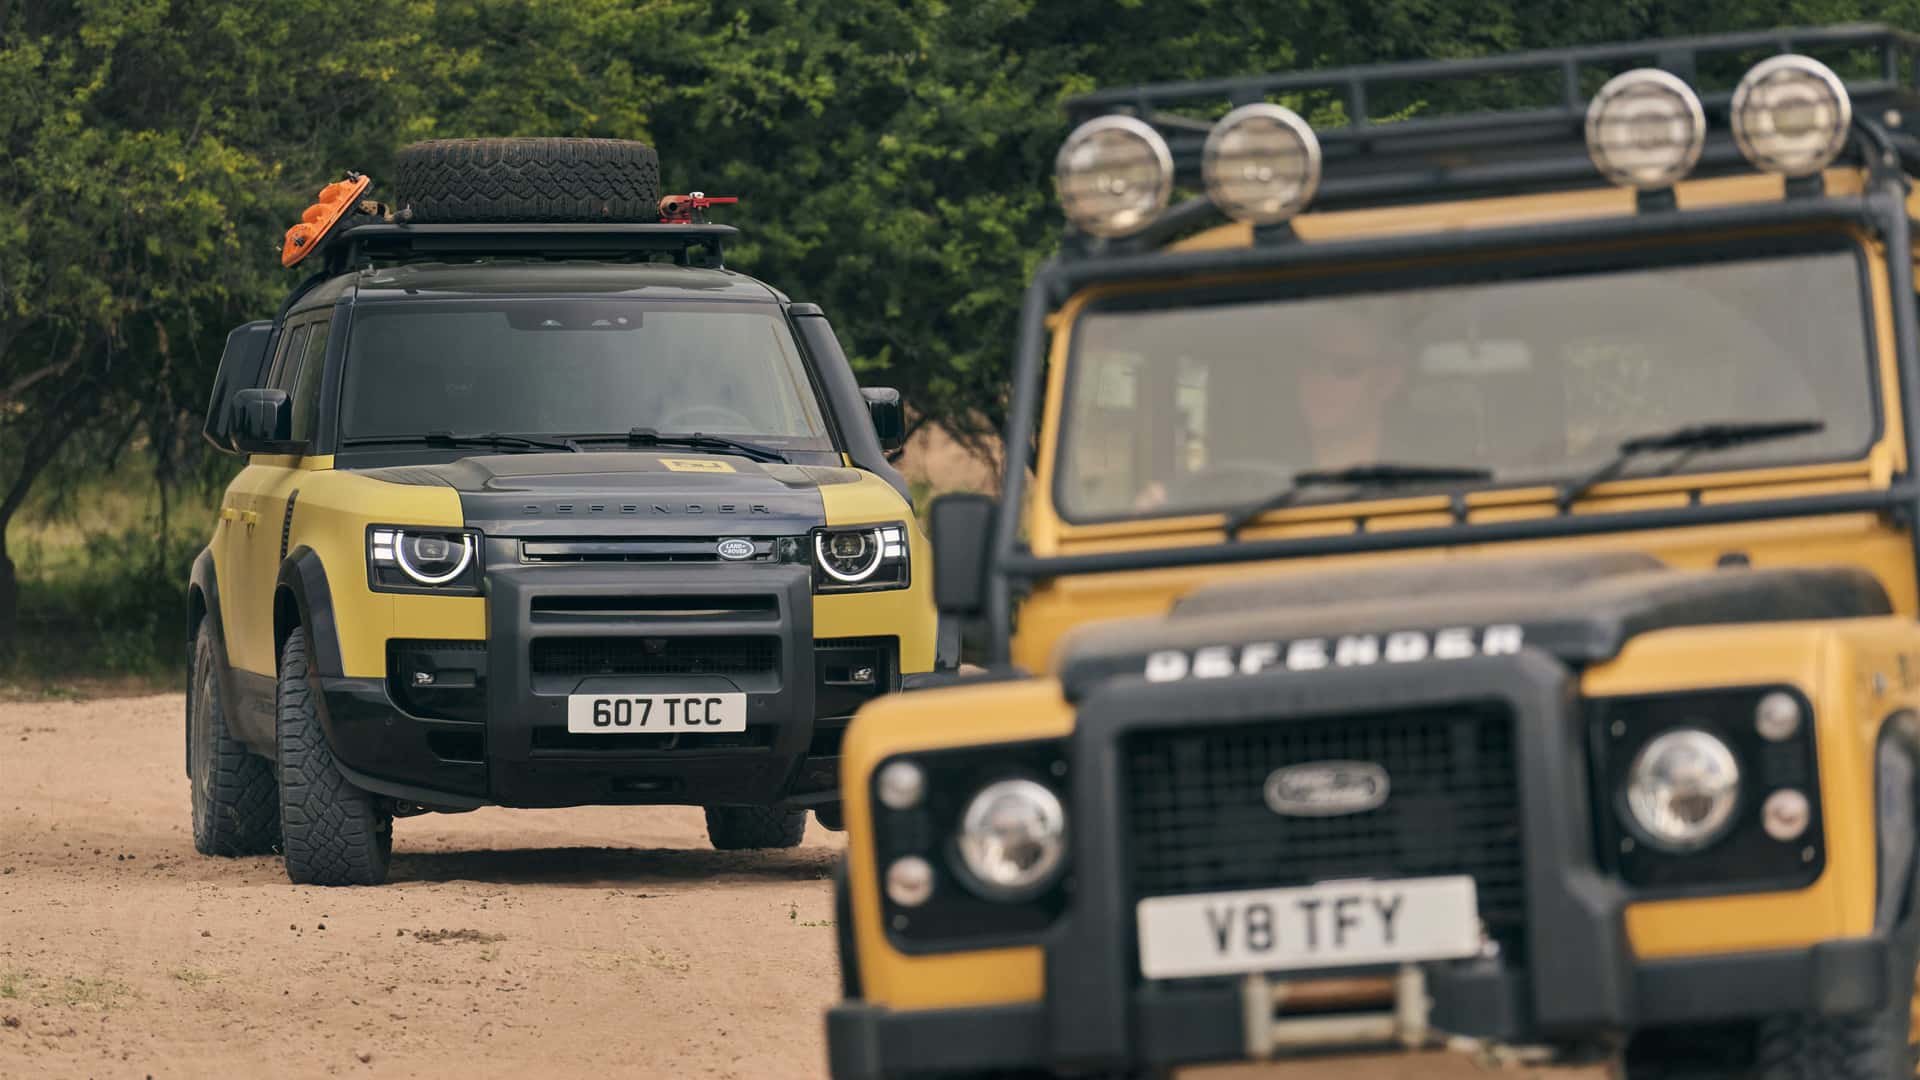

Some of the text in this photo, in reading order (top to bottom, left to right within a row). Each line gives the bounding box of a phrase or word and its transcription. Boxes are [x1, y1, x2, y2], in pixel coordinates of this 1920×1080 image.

[522, 503, 770, 515] DEFENDER
[1145, 624, 1523, 682] DEFENDER
[593, 697, 722, 727] 607 TCC
[1204, 893, 1404, 954] V8 TFY
